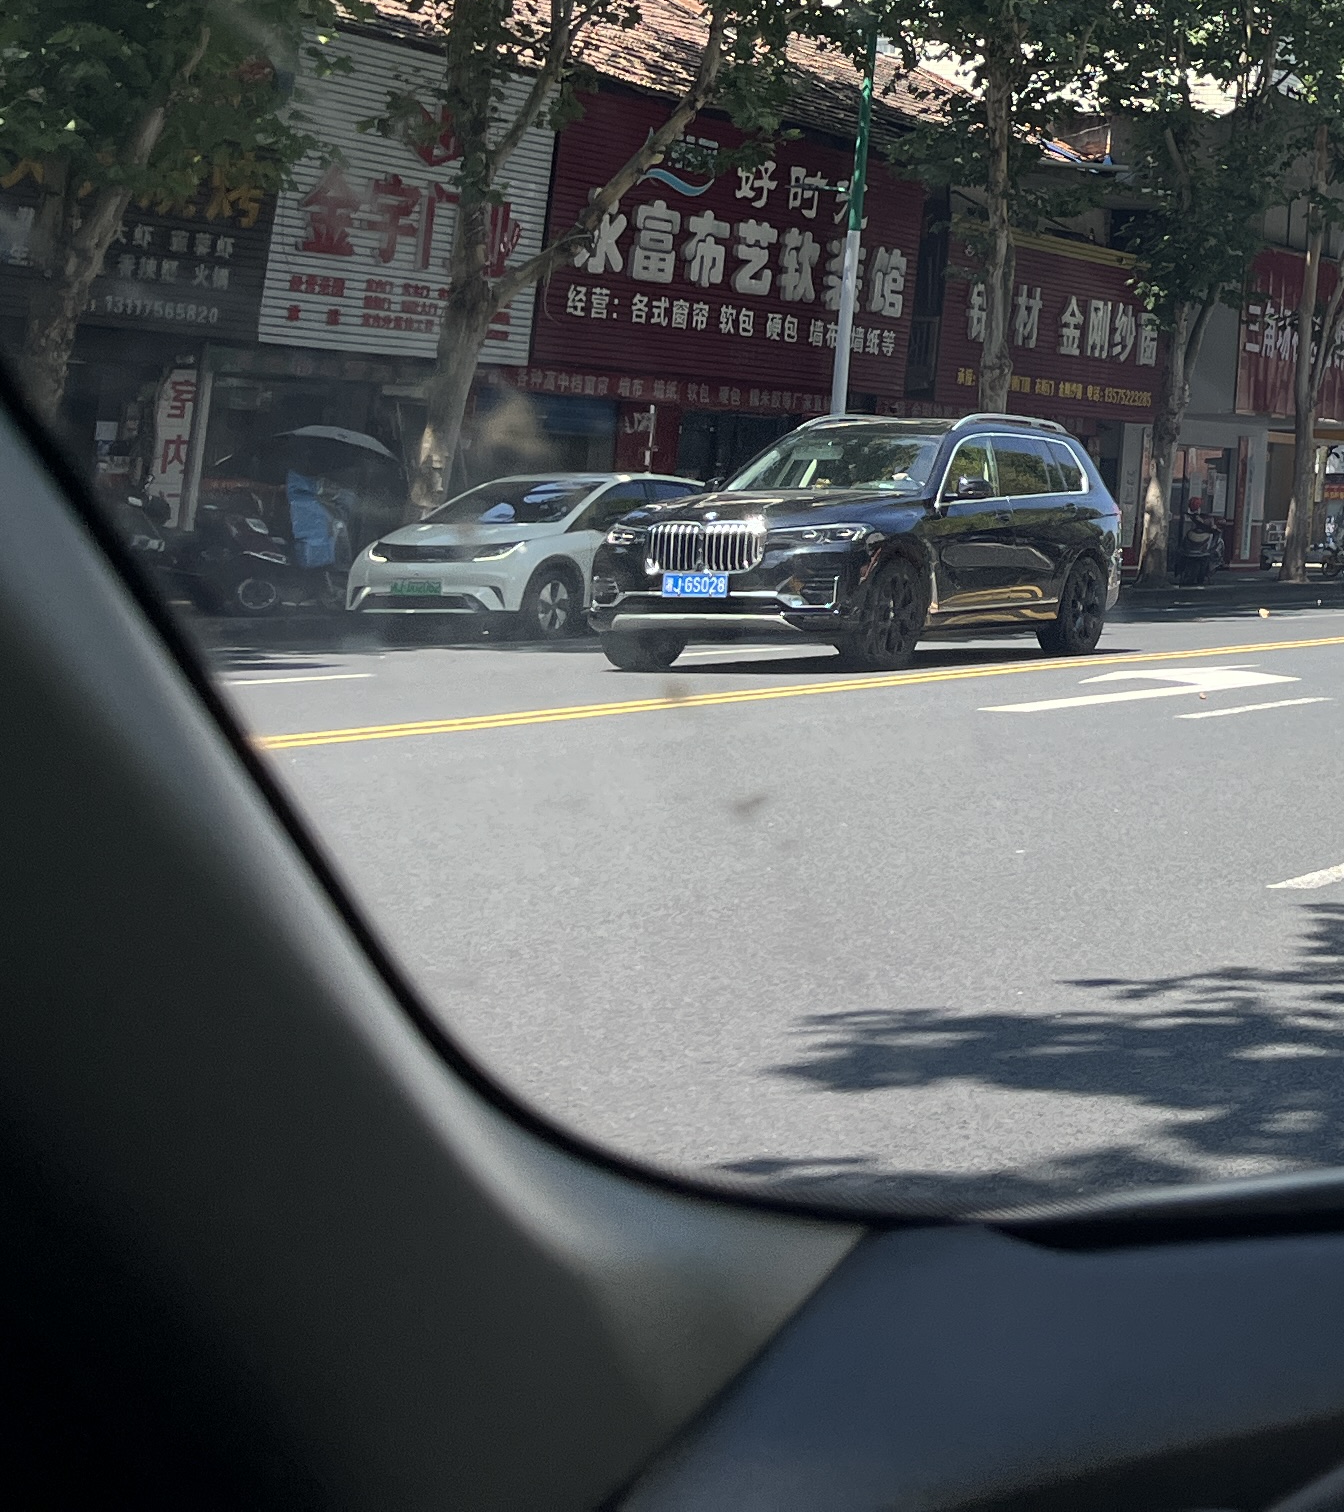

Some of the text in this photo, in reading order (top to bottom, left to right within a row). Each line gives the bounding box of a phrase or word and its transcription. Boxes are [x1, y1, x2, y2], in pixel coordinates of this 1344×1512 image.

[630, 294, 709, 332] 各式窗帘
[717, 303, 755, 337] 软包
[765, 312, 799, 343] 硬包
